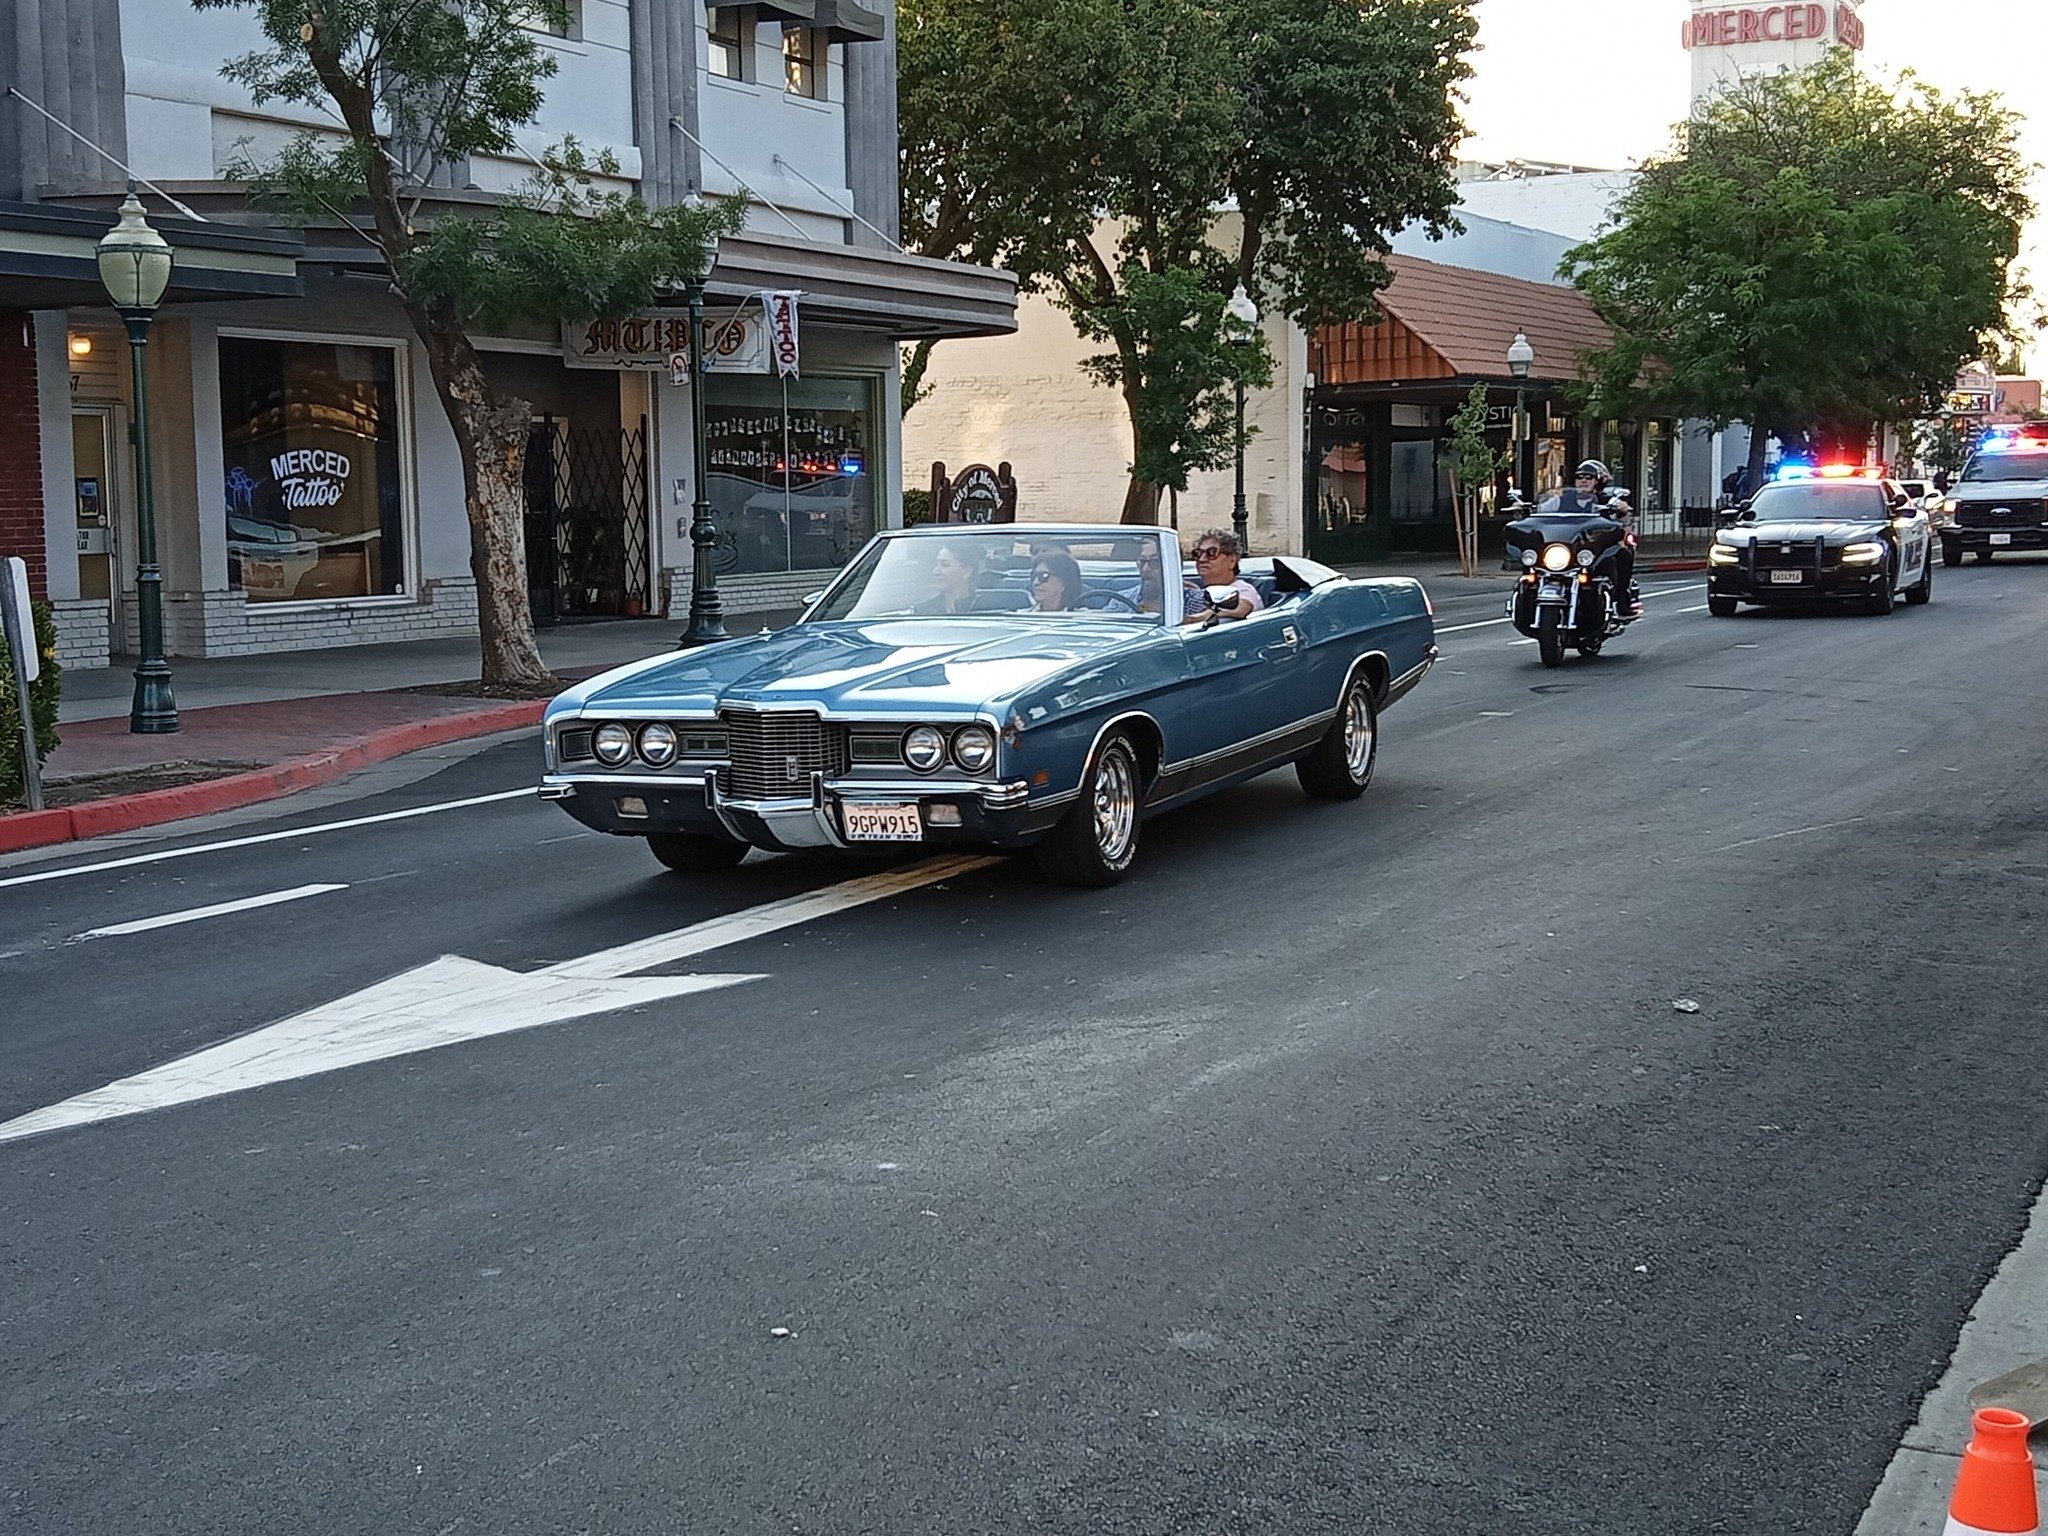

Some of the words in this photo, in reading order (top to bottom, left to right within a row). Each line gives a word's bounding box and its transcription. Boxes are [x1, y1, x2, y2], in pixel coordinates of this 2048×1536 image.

[1691, 3, 1826, 47] MERCED
[773, 294, 797, 363] TATTOO
[70, 375, 80, 391] 7
[270, 449, 350, 480] MERCED
[281, 477, 342, 510] Tattoo
[952, 484, 968, 511] City
[969, 470, 978, 487] of
[979, 470, 1003, 509] Merced
[849, 815, 919, 834] 9GPW915
